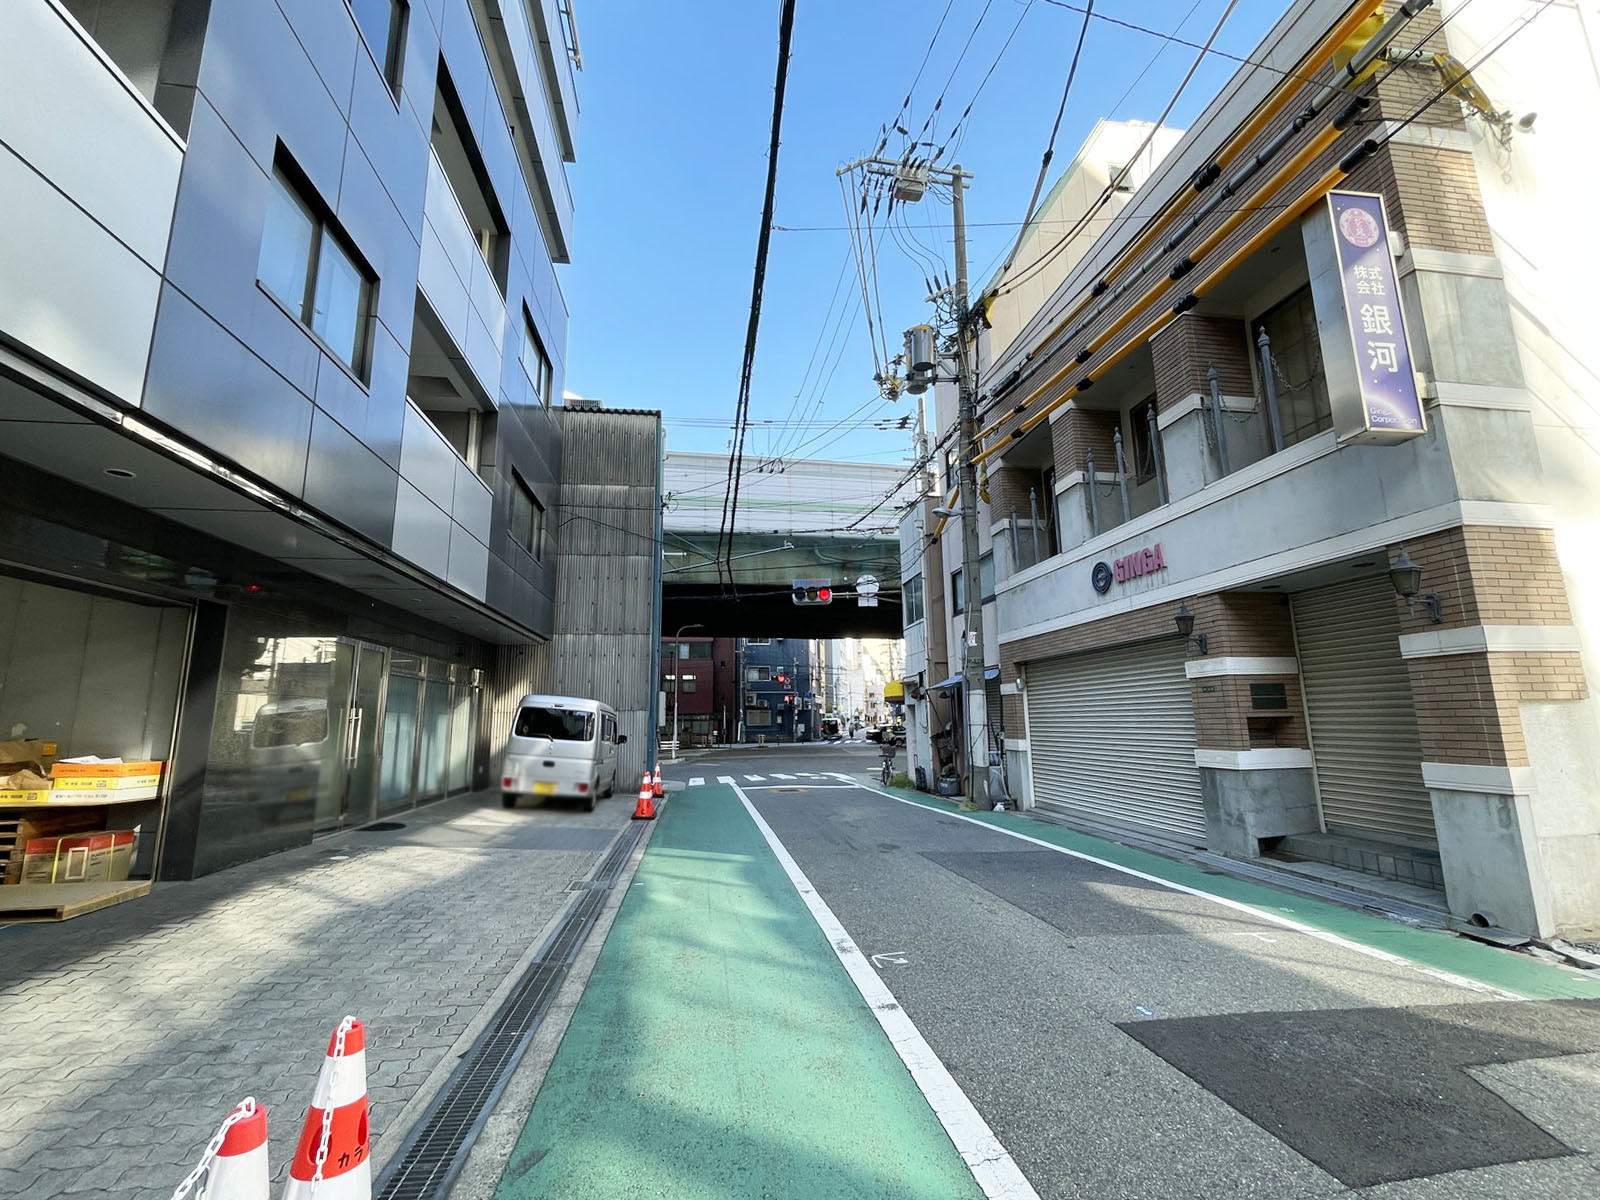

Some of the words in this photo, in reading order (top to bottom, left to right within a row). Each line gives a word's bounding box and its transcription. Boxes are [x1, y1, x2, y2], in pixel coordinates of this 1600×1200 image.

[1360, 303, 1399, 373] 銀河
[1113, 543, 1167, 584] GINGA
[338, 1145, 368, 1168] カラ
